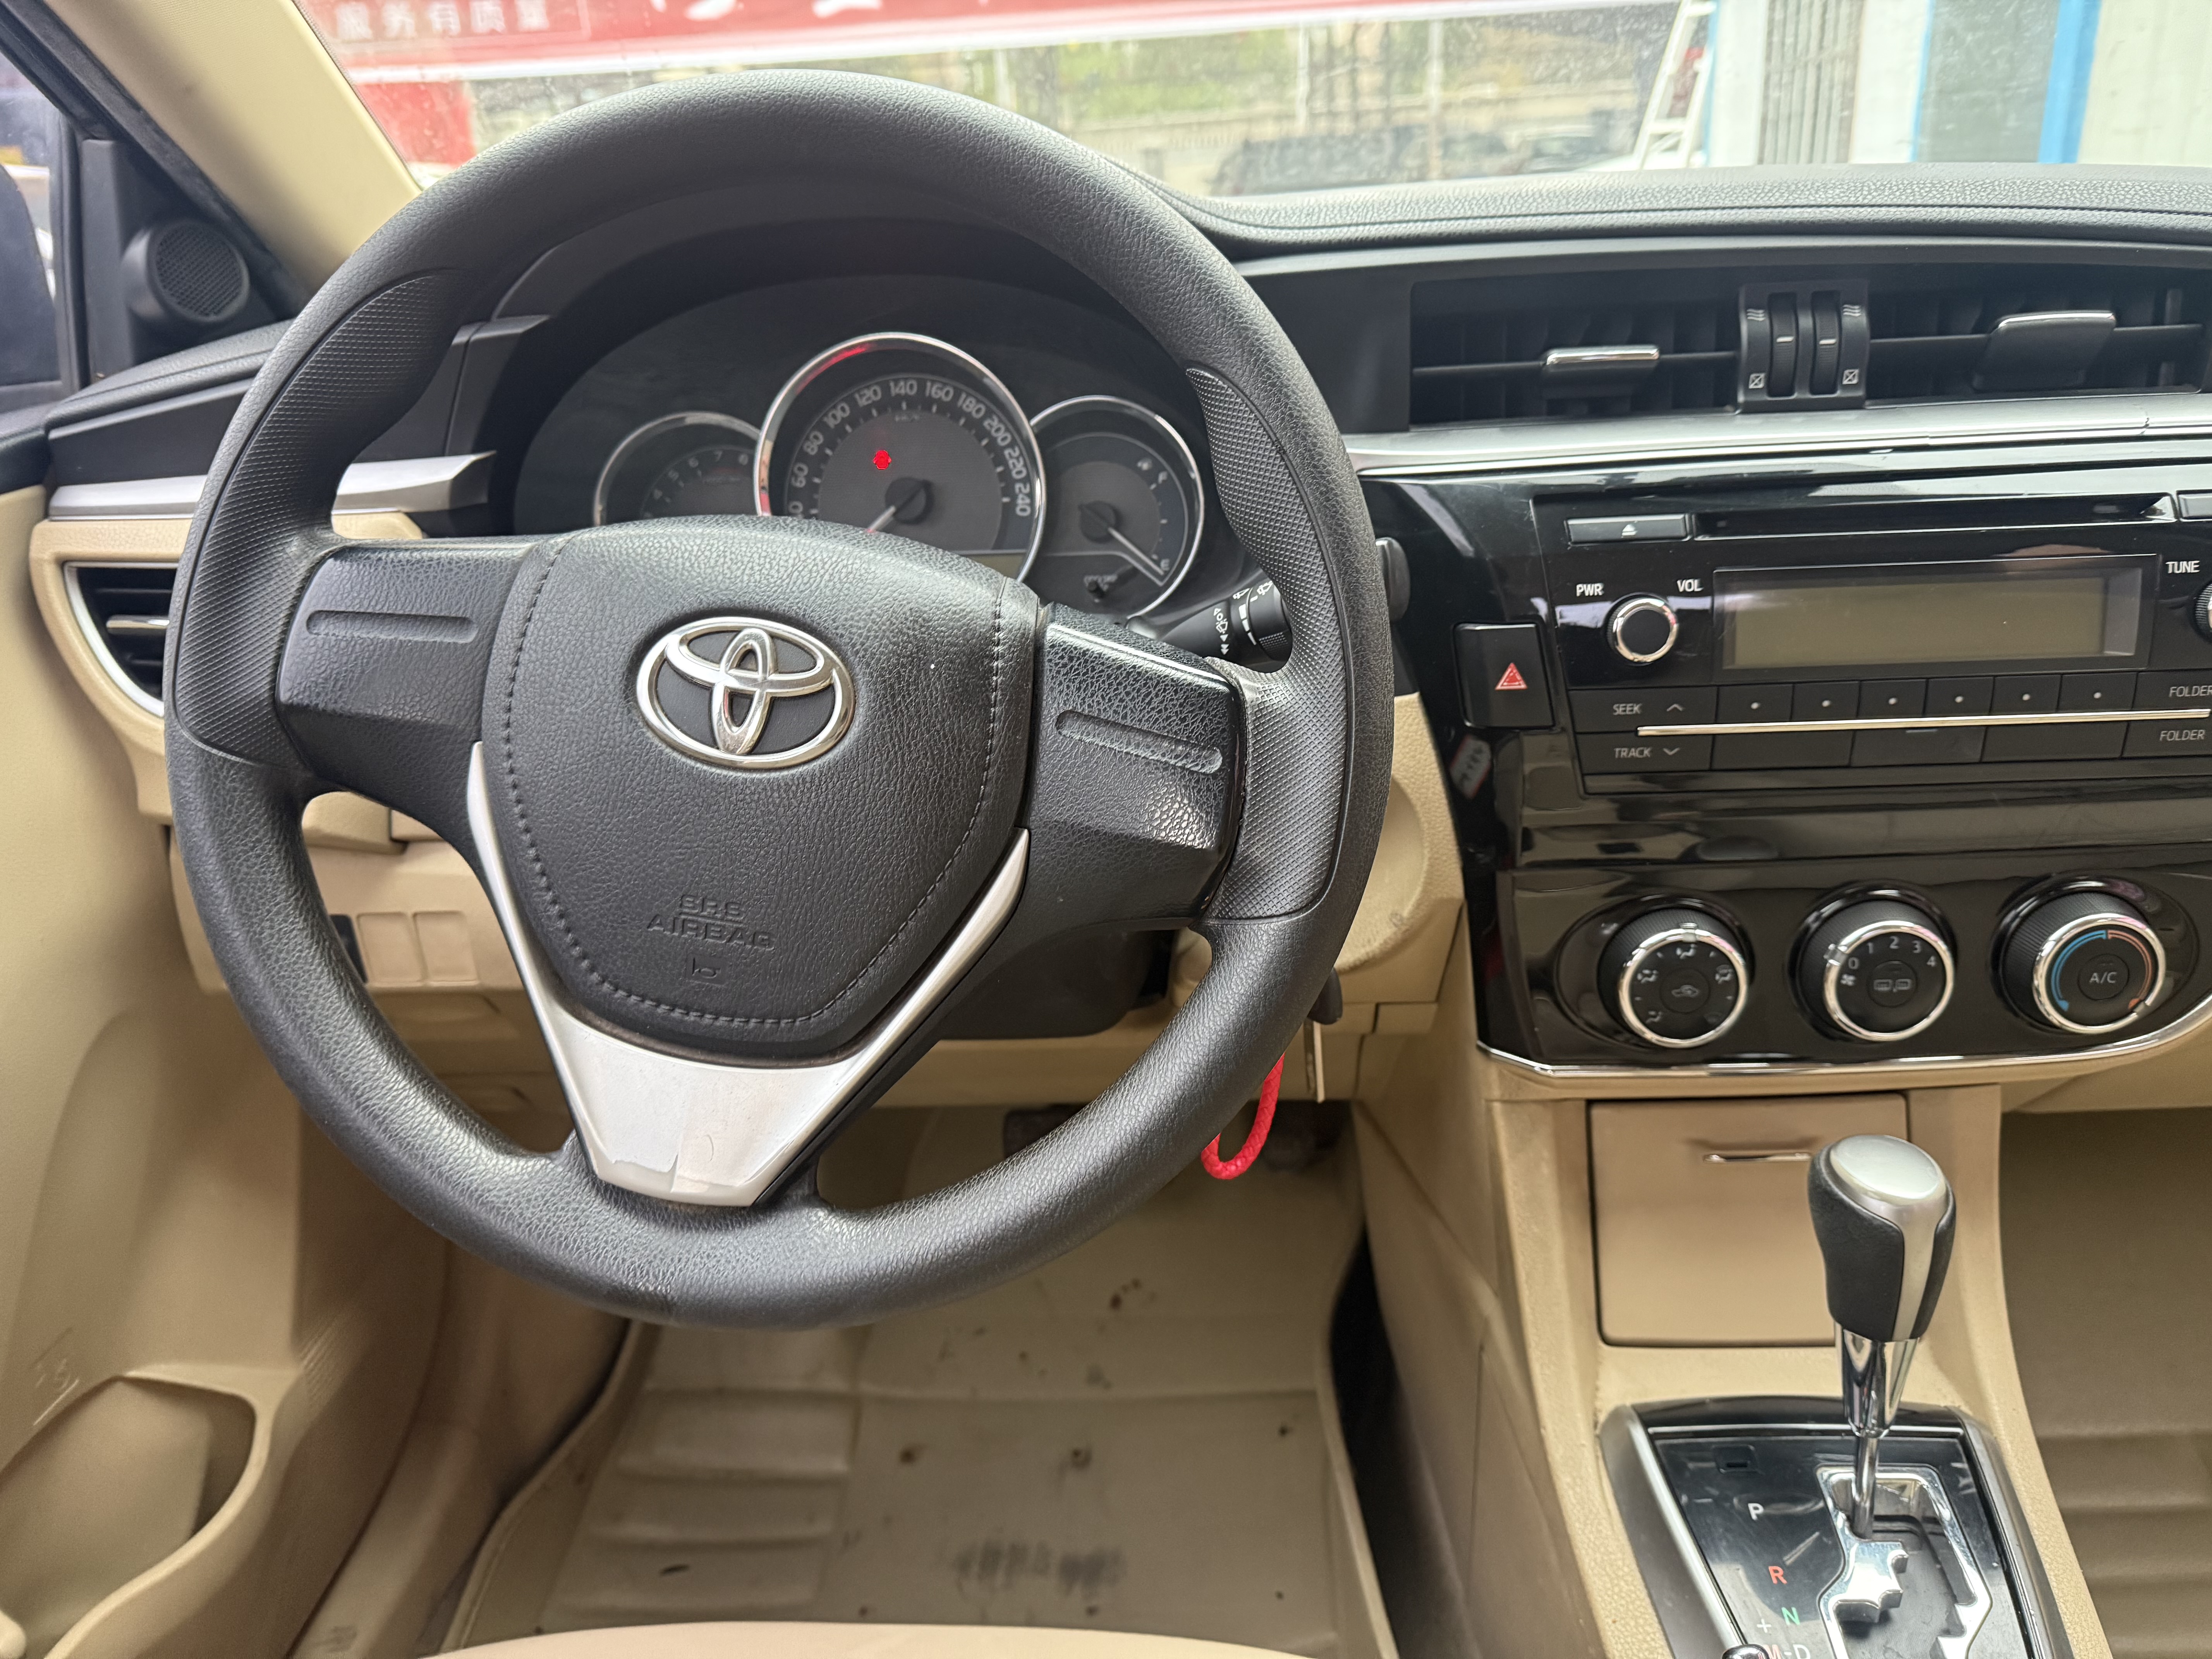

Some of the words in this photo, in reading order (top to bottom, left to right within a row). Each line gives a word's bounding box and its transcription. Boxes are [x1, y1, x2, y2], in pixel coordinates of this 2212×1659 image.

[854, 385, 883, 408] 120
[889, 379, 918, 397] 140
[925, 381, 954, 403] 160
[957, 392, 986, 419] 180
[823, 402, 850, 429] 100
[983, 414, 1012, 446] 200
[802, 431, 824, 456] 80
[1004, 446, 1027, 480] 220
[791, 464, 809, 488] 60
[1015, 481, 1032, 517] 240
[788, 501, 804, 518] 0
[2166, 560, 2200, 573] TUNE
[1576, 583, 1604, 597] PWR
[1677, 579, 1703, 592] VOL
[1613, 704, 1643, 716] SEEK
[2160, 730, 2205, 741] FOLDER
[1614, 747, 1652, 759] TRACK
[647, 914, 775, 951] AIRBAG
[1866, 943, 1874, 954] 1
[1889, 936, 1899, 949] 2
[1912, 941, 1922, 953] 3
[1848, 957, 1859, 970] 0
[1927, 955, 1936, 967] 4
[2089, 971, 2117, 984] A/C
[1748, 1503, 1764, 1520] P
[1769, 1566, 1787, 1584] R
[1782, 1607, 1800, 1625] N
